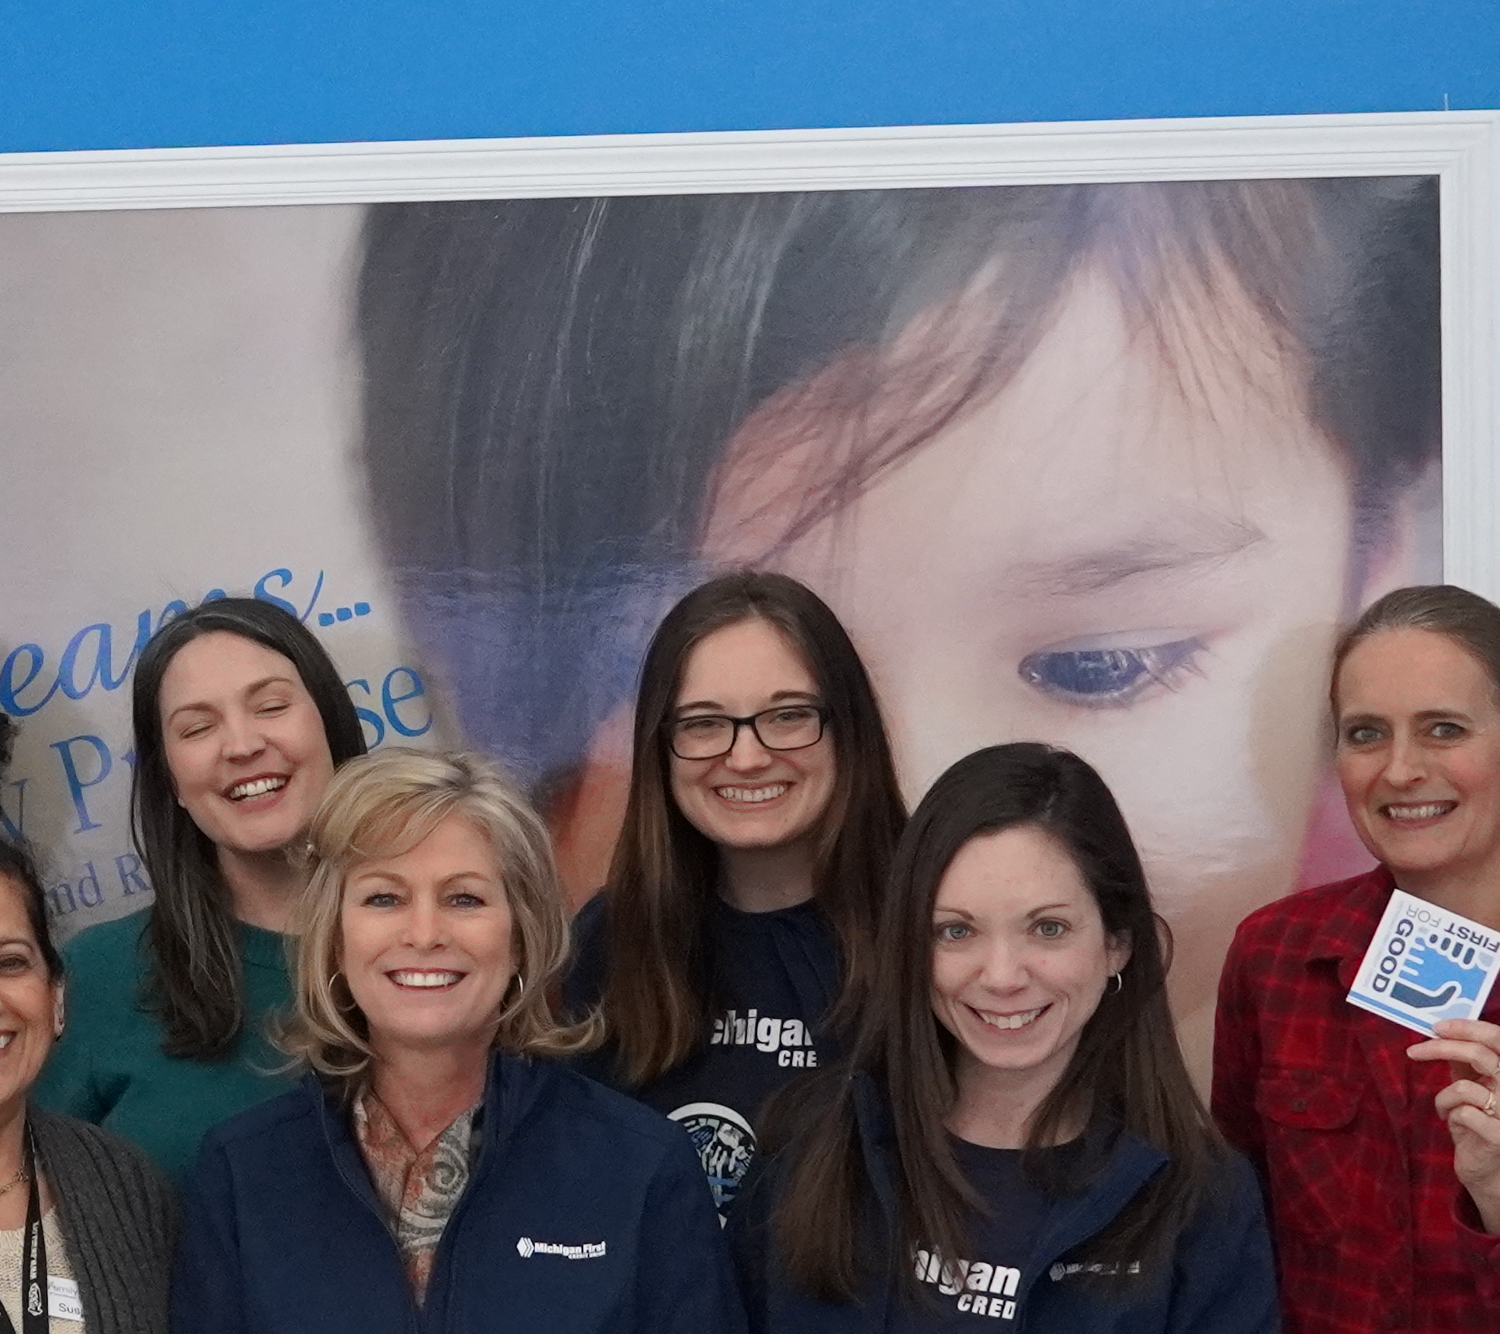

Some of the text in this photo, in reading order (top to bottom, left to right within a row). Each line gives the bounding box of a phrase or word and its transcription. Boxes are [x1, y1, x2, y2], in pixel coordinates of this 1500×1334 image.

[49, 861, 106, 916] nd
[1406, 904, 1442, 929] FOR
[1372, 918, 1414, 993] GOOD
[778, 1050, 818, 1067] CRE
[534, 1241, 606, 1256] Michigan First
[957, 1293, 1016, 1320] CRED
